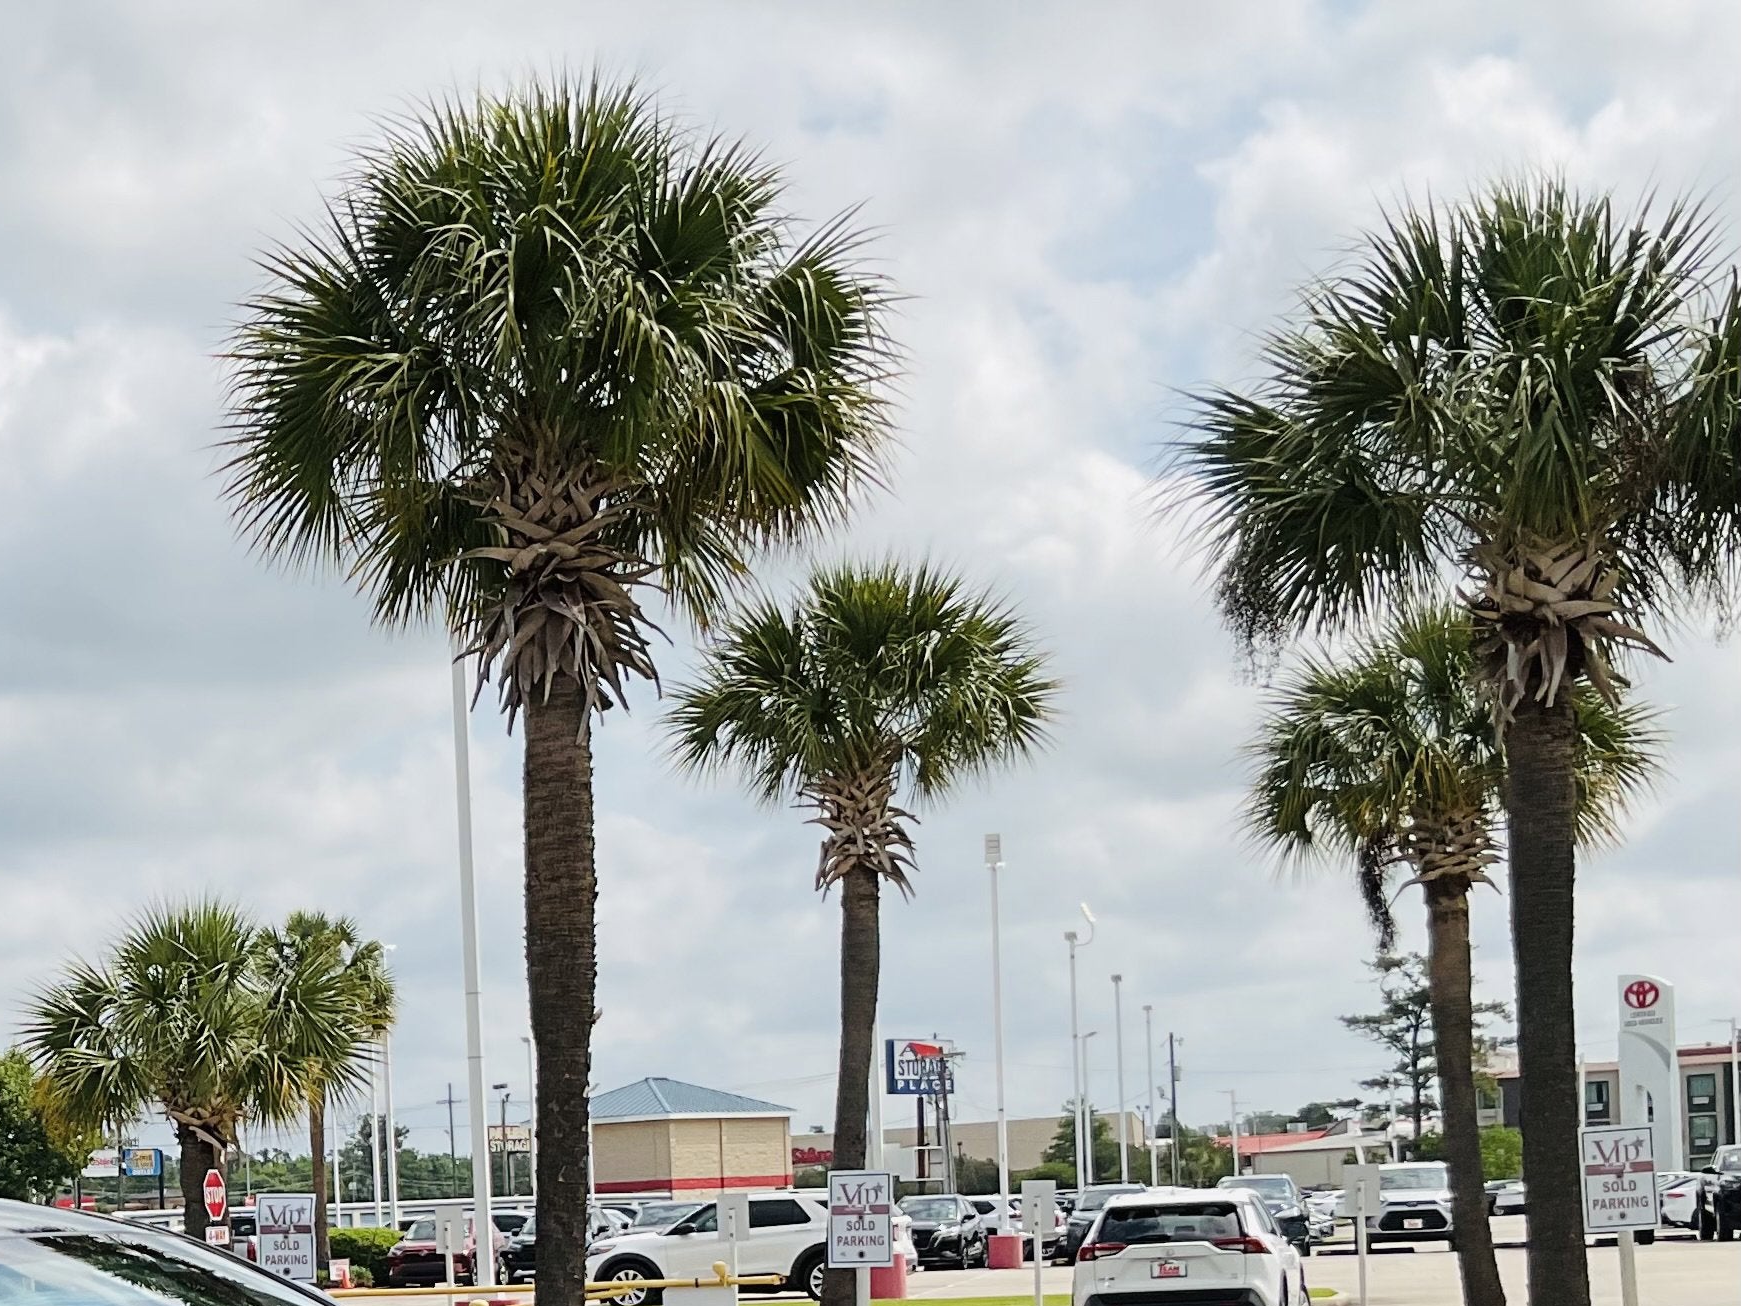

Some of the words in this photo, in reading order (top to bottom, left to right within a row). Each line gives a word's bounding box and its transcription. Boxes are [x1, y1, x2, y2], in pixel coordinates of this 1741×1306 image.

[897, 1080, 952, 1091] PLACE
[1602, 1180, 1637, 1193] SOLD
[205, 1186, 224, 1204] STOP
[1592, 1196, 1649, 1210] PARKING
[846, 1220, 875, 1231] SOLD
[273, 1239, 300, 1251] SOLD
[837, 1235, 885, 1246] PARKING
[265, 1255, 308, 1265] PARKING
